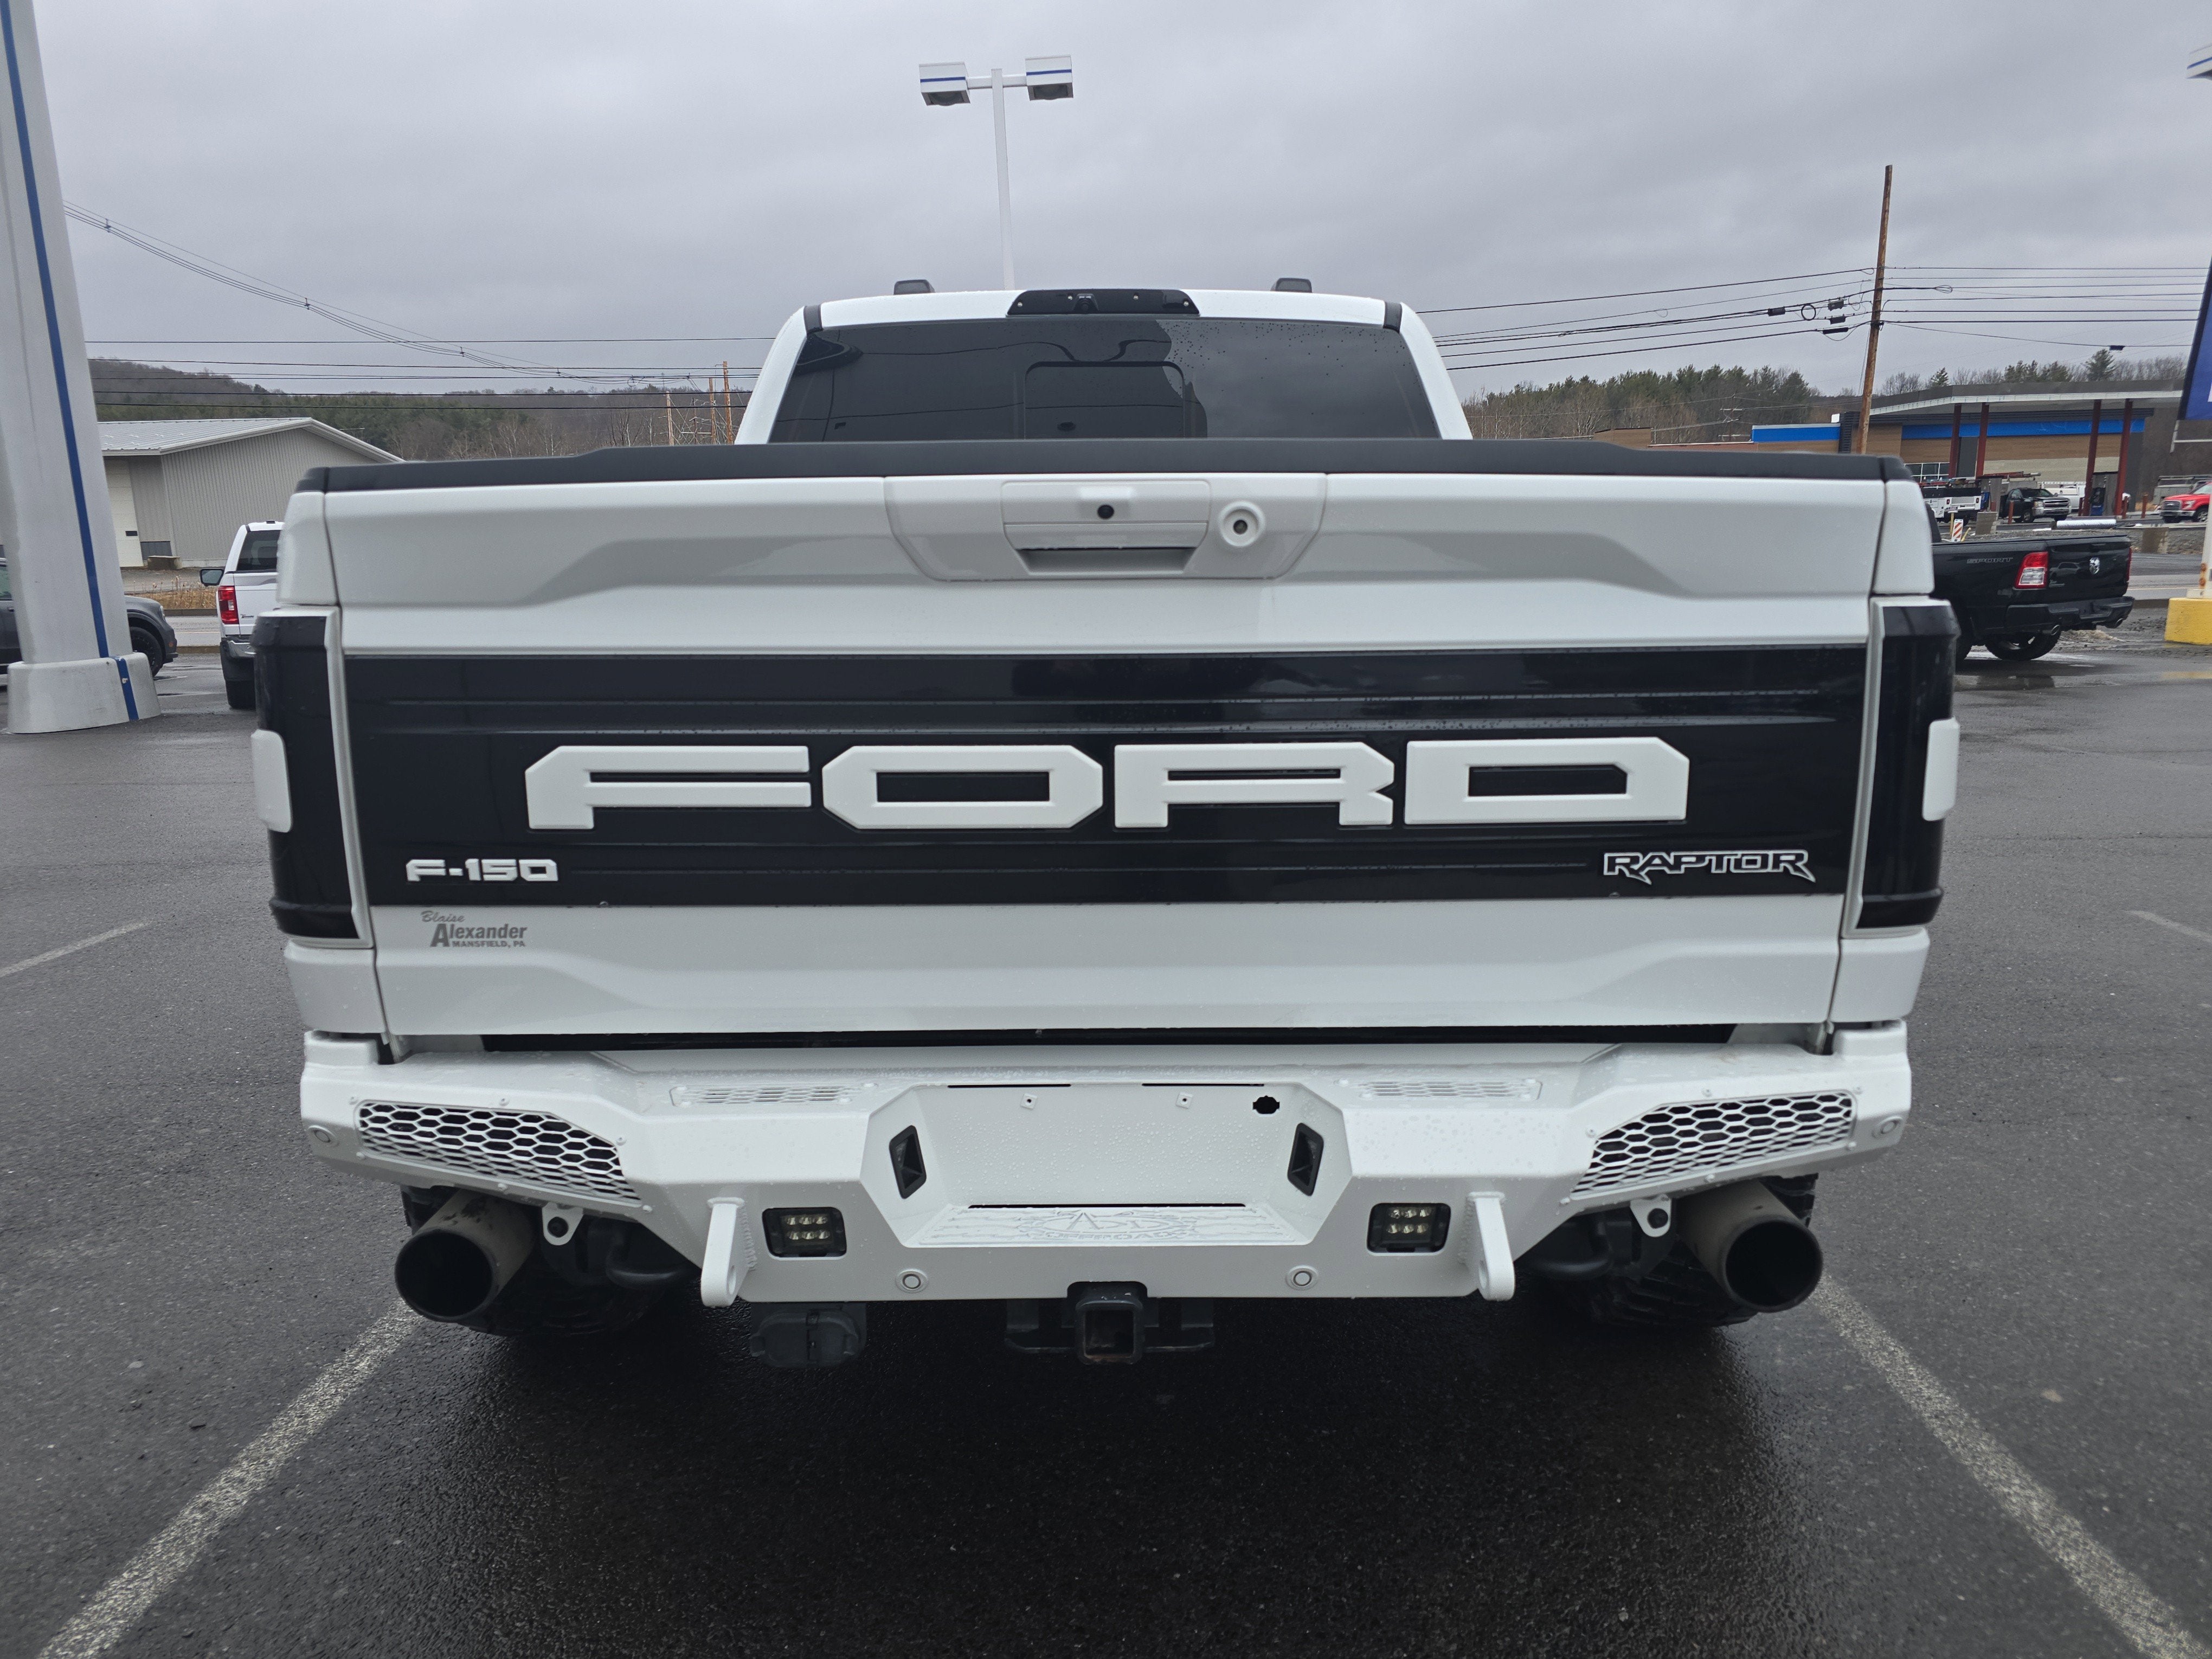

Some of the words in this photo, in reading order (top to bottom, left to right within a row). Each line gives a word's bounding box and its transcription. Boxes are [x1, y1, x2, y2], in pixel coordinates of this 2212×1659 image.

[525, 736, 1690, 829] FORD
[406, 858, 558, 882] F-150
[1603, 849, 1816, 885] RAPTOR
[420, 910, 465, 923] Blaise
[430, 923, 528, 947] Alexander
